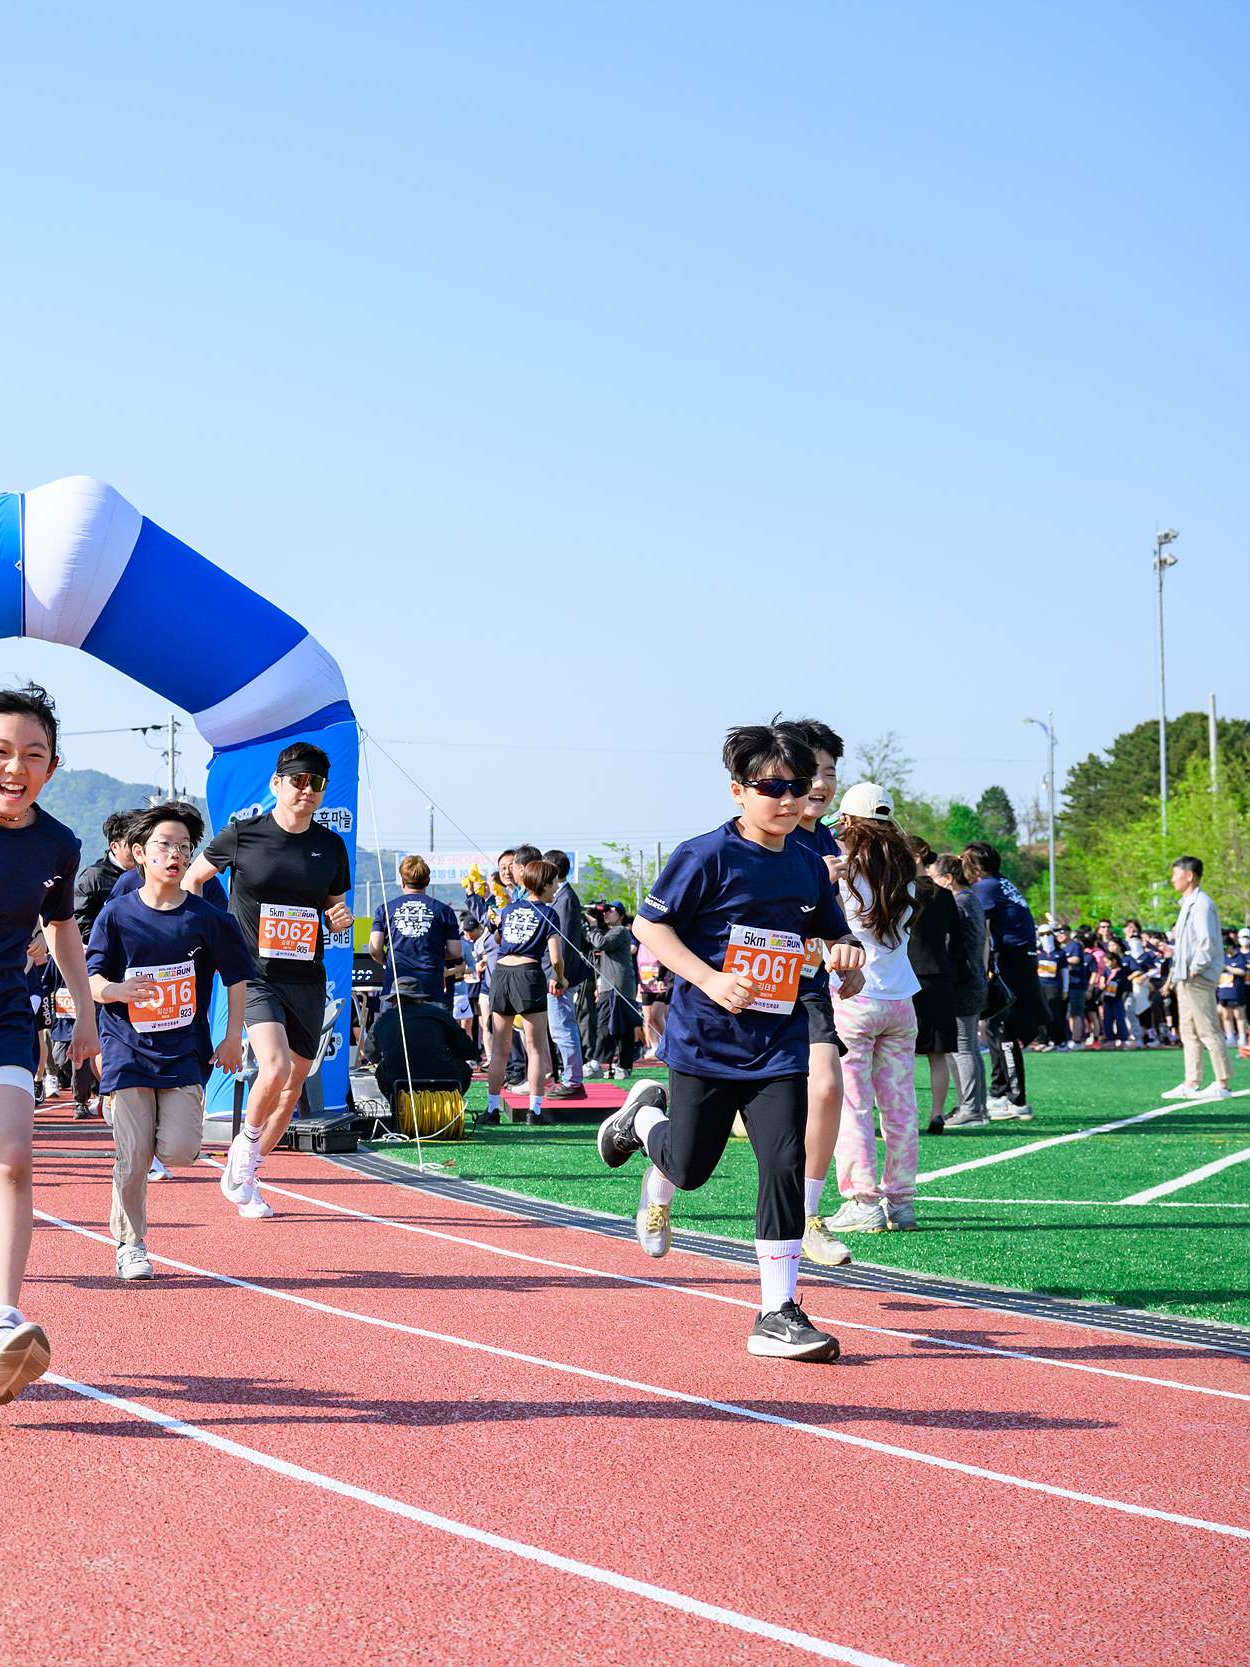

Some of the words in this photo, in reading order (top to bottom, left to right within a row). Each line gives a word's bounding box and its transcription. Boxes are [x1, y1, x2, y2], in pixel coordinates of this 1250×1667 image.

[269, 907, 285, 917] 5km
[264, 920, 314, 942] 5062
[744, 931, 766, 947] 5km
[296, 945, 308, 954] 905
[731, 949, 799, 985] 5061
[180, 1008, 192, 1018] 923
